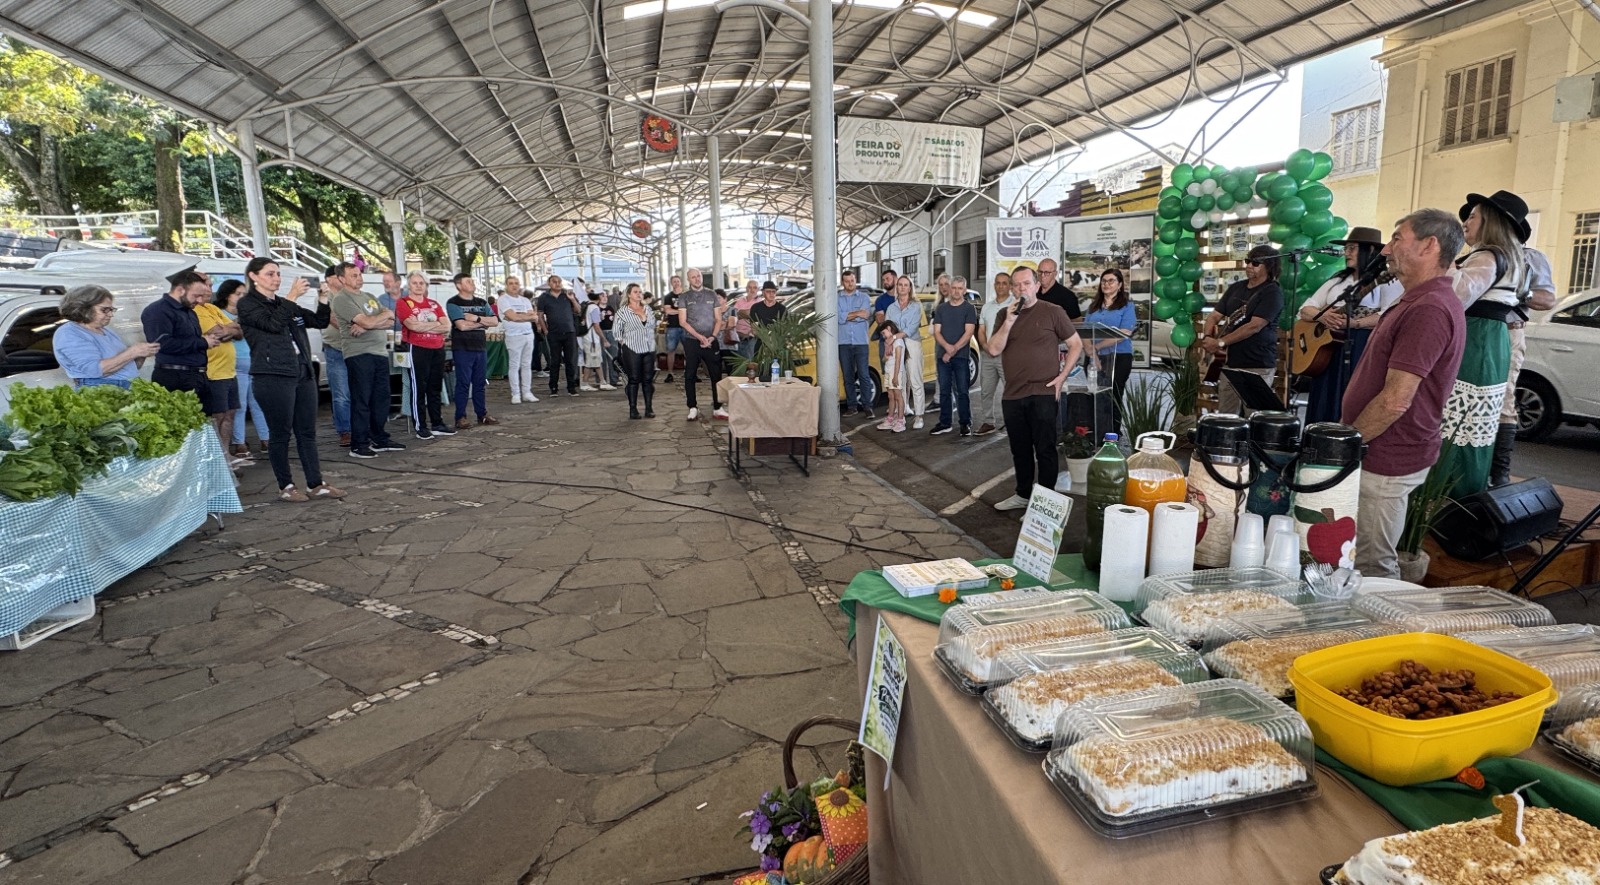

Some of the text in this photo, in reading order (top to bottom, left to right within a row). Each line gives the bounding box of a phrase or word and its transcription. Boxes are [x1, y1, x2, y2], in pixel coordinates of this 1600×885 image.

[855, 140, 900, 151] FEIRA DO
[855, 150, 901, 159] PRODUTOR
[1030, 502, 1060, 521] AGRÍCOLA
[1047, 499, 1063, 513] Feira
